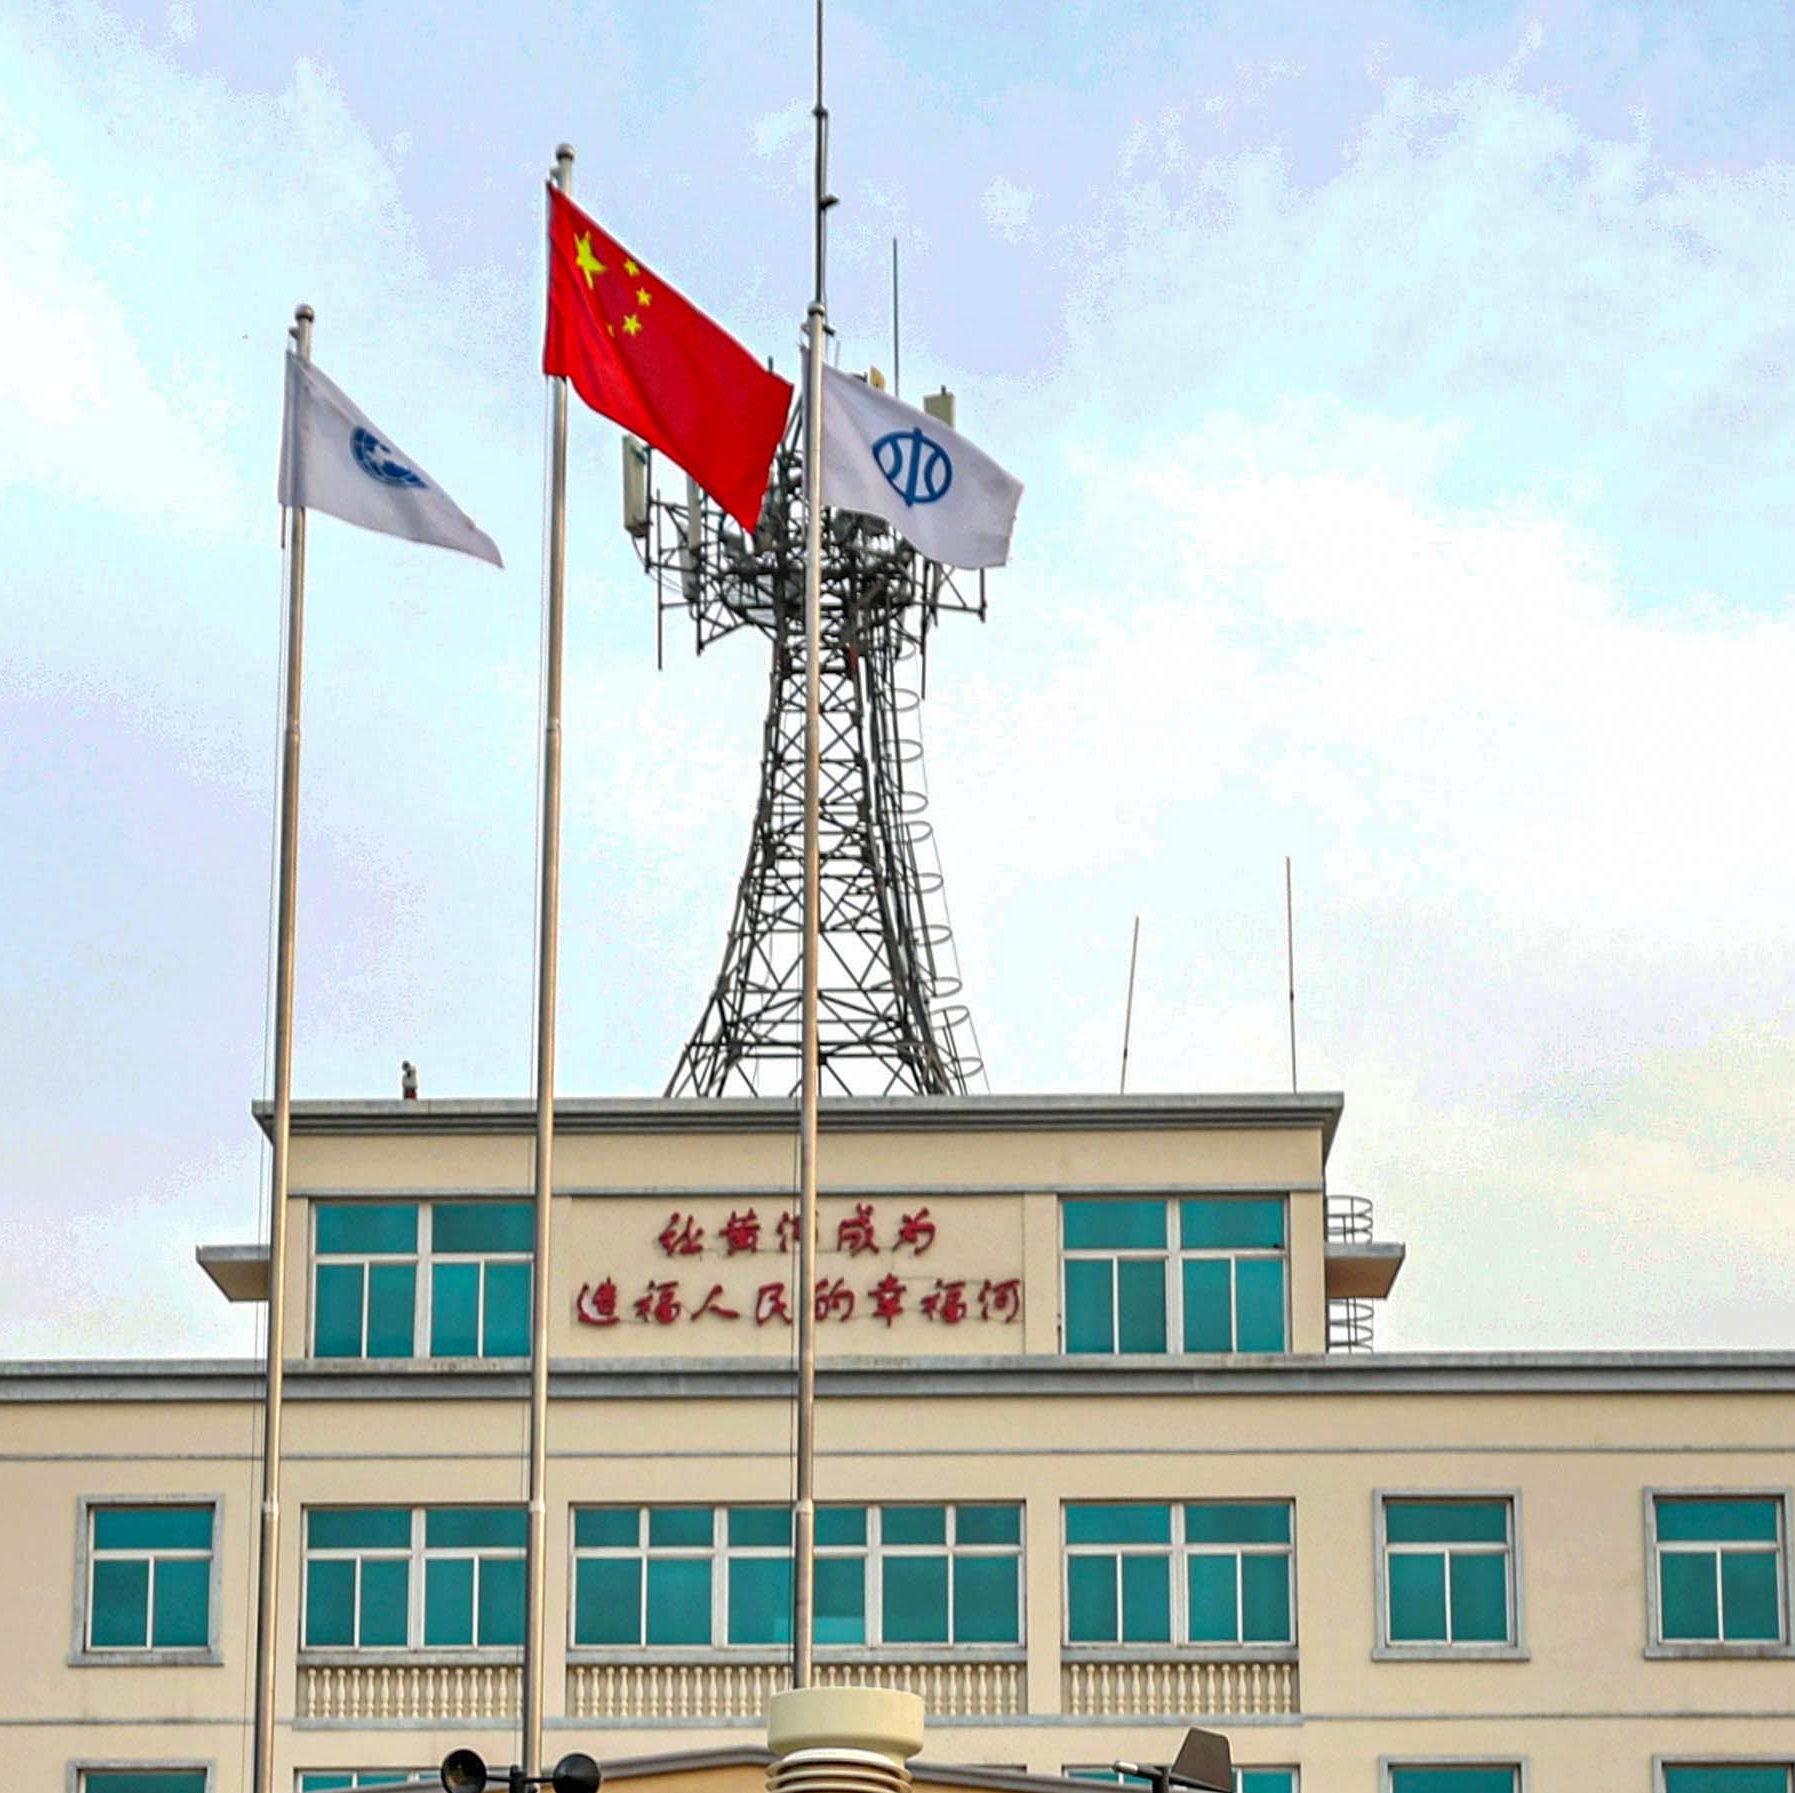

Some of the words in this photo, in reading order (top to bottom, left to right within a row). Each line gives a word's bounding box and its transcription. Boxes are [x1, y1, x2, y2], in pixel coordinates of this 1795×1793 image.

[577, 1272, 1021, 1327] 造福人民的幸福河
